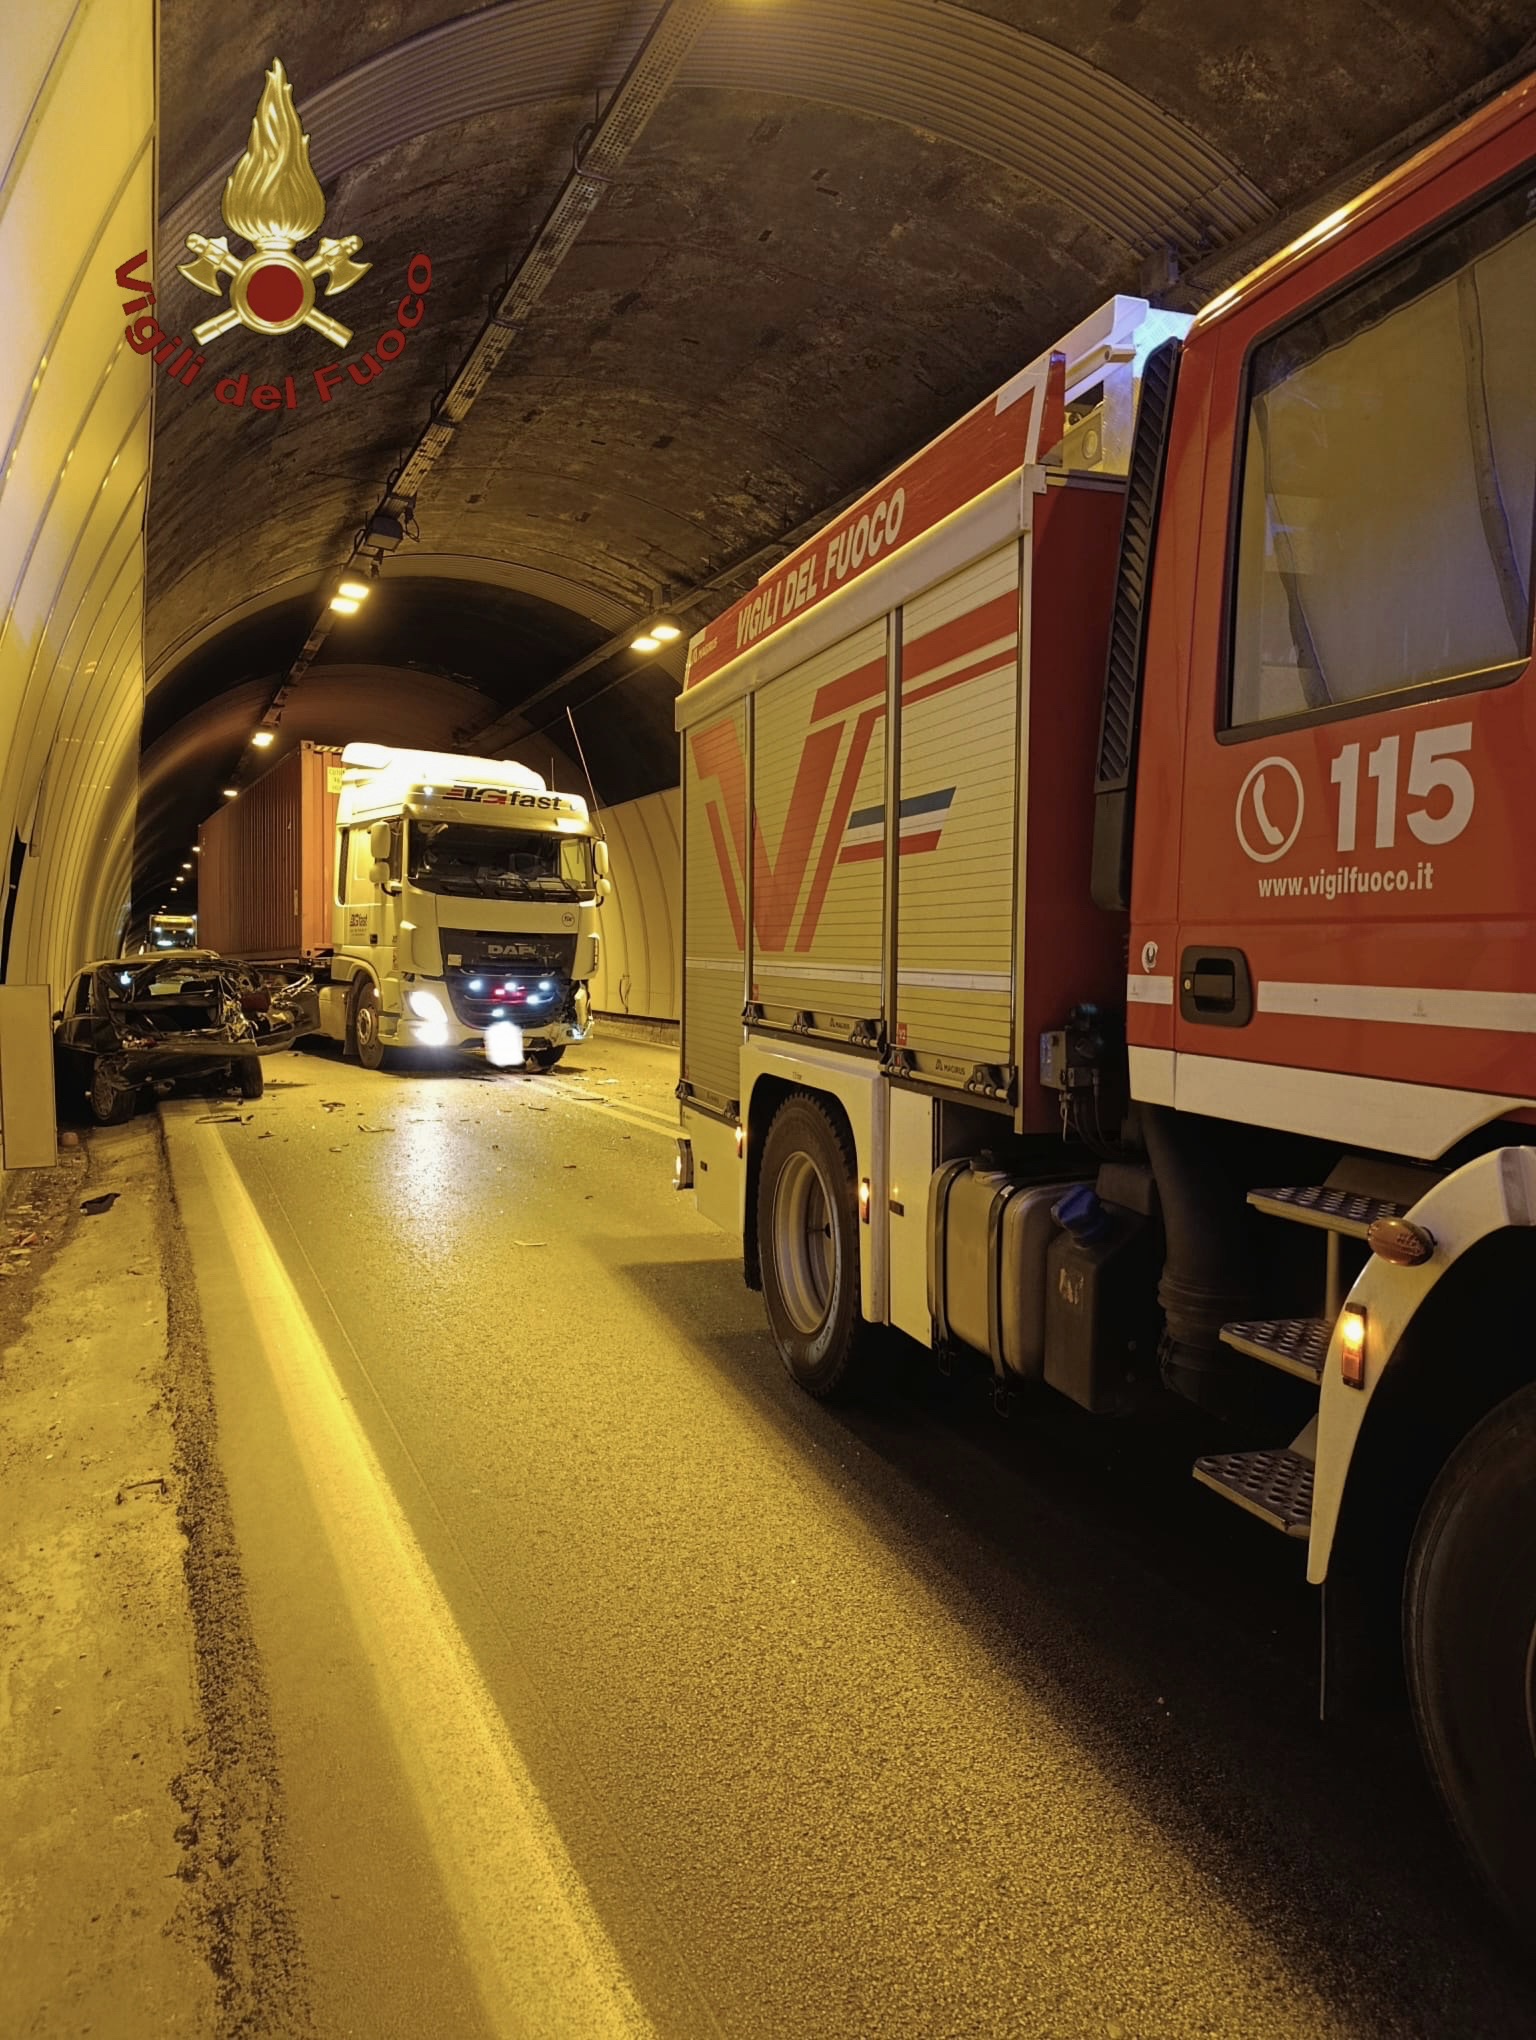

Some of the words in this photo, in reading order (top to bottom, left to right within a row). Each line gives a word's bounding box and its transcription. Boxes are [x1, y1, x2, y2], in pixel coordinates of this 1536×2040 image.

[736, 580, 782, 649] VIGILI
[782, 554, 817, 618] DEL
[823, 487, 905, 590] FUOCO
[1330, 721, 1475, 852] 115
[1258, 862, 1434, 900] www.vigilfuoco.it
[488, 944, 535, 955] DAF
